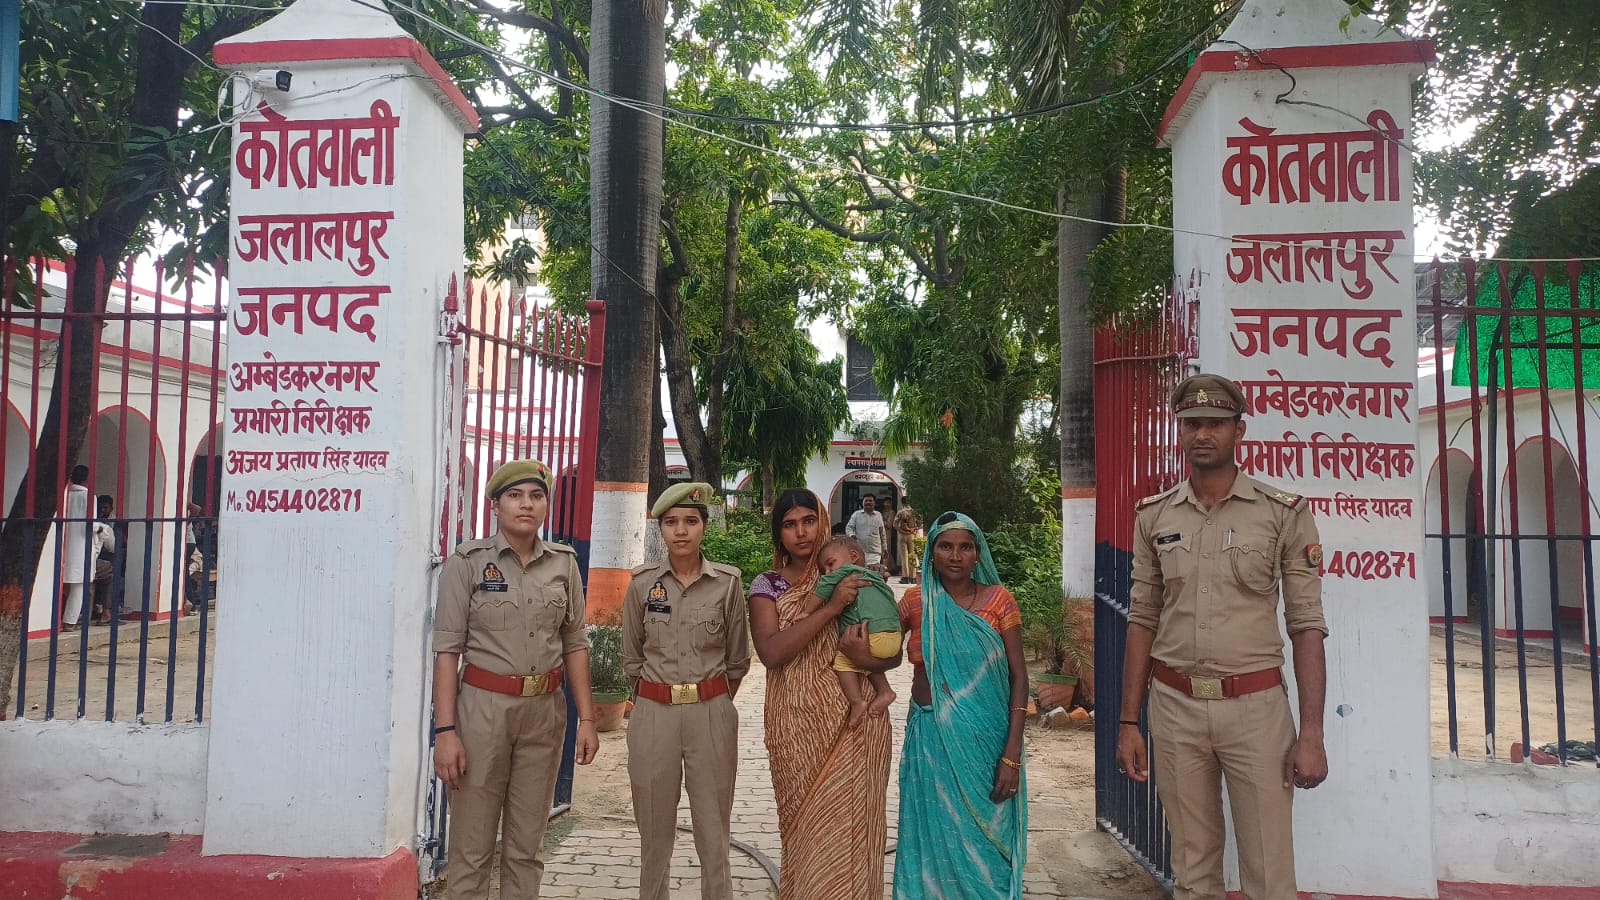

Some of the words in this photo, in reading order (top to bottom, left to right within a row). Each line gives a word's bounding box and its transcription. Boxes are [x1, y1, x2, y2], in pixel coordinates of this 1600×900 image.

[236, 98, 401, 190] कोतवाली
[1222, 109, 1405, 206] कोतवाली
[234, 211, 395, 277] जलालपुर
[1226, 230, 1406, 300] जलालपुर
[234, 286, 392, 343] जनपद
[1230, 308, 1403, 368] जनपद
[230, 398, 291, 436] प्रभारी
[292, 398, 372, 436] निरीक्षक
[226, 449, 274, 475] अजय
[276, 451, 322, 473] प्रताप
[322, 446, 352, 473] सिंह
[352, 450, 390, 471] यादव
[1235, 431, 1307, 480] प्रभारी
[1309, 432, 1415, 481] निरीक्षक
[246, 488, 362, 513] 9454402871
[1334, 491, 1370, 523] सिंह
[1370, 499, 1413, 520] यादव
